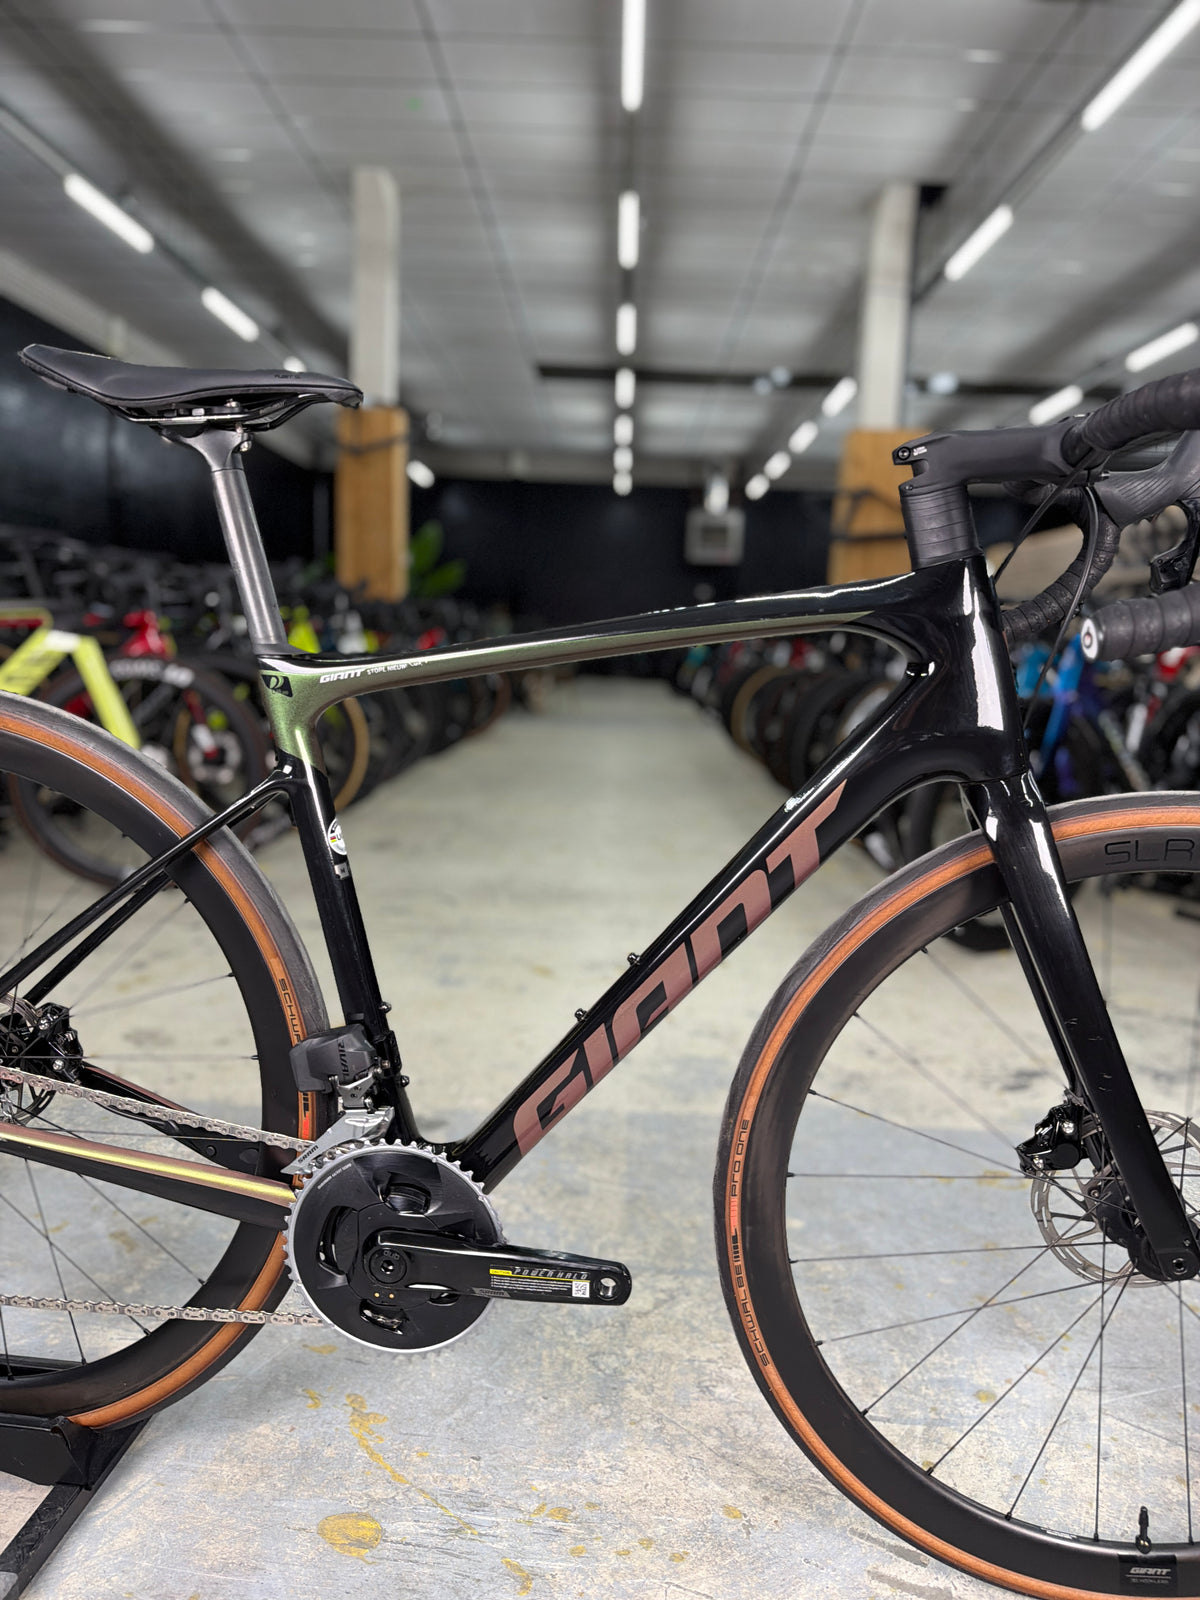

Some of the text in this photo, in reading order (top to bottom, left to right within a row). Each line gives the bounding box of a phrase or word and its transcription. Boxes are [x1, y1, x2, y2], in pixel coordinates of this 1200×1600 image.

[319, 669, 365, 683] GIANT
[1104, 839, 1195, 866] SLR
[513, 778, 847, 1157] GIANT
[338, 1039, 350, 1079] RIVAL
[298, 1144, 319, 1164] SRAM
[735, 1263, 770, 1367] SCHWALBE
[1130, 1567, 1171, 1575] GIANT
